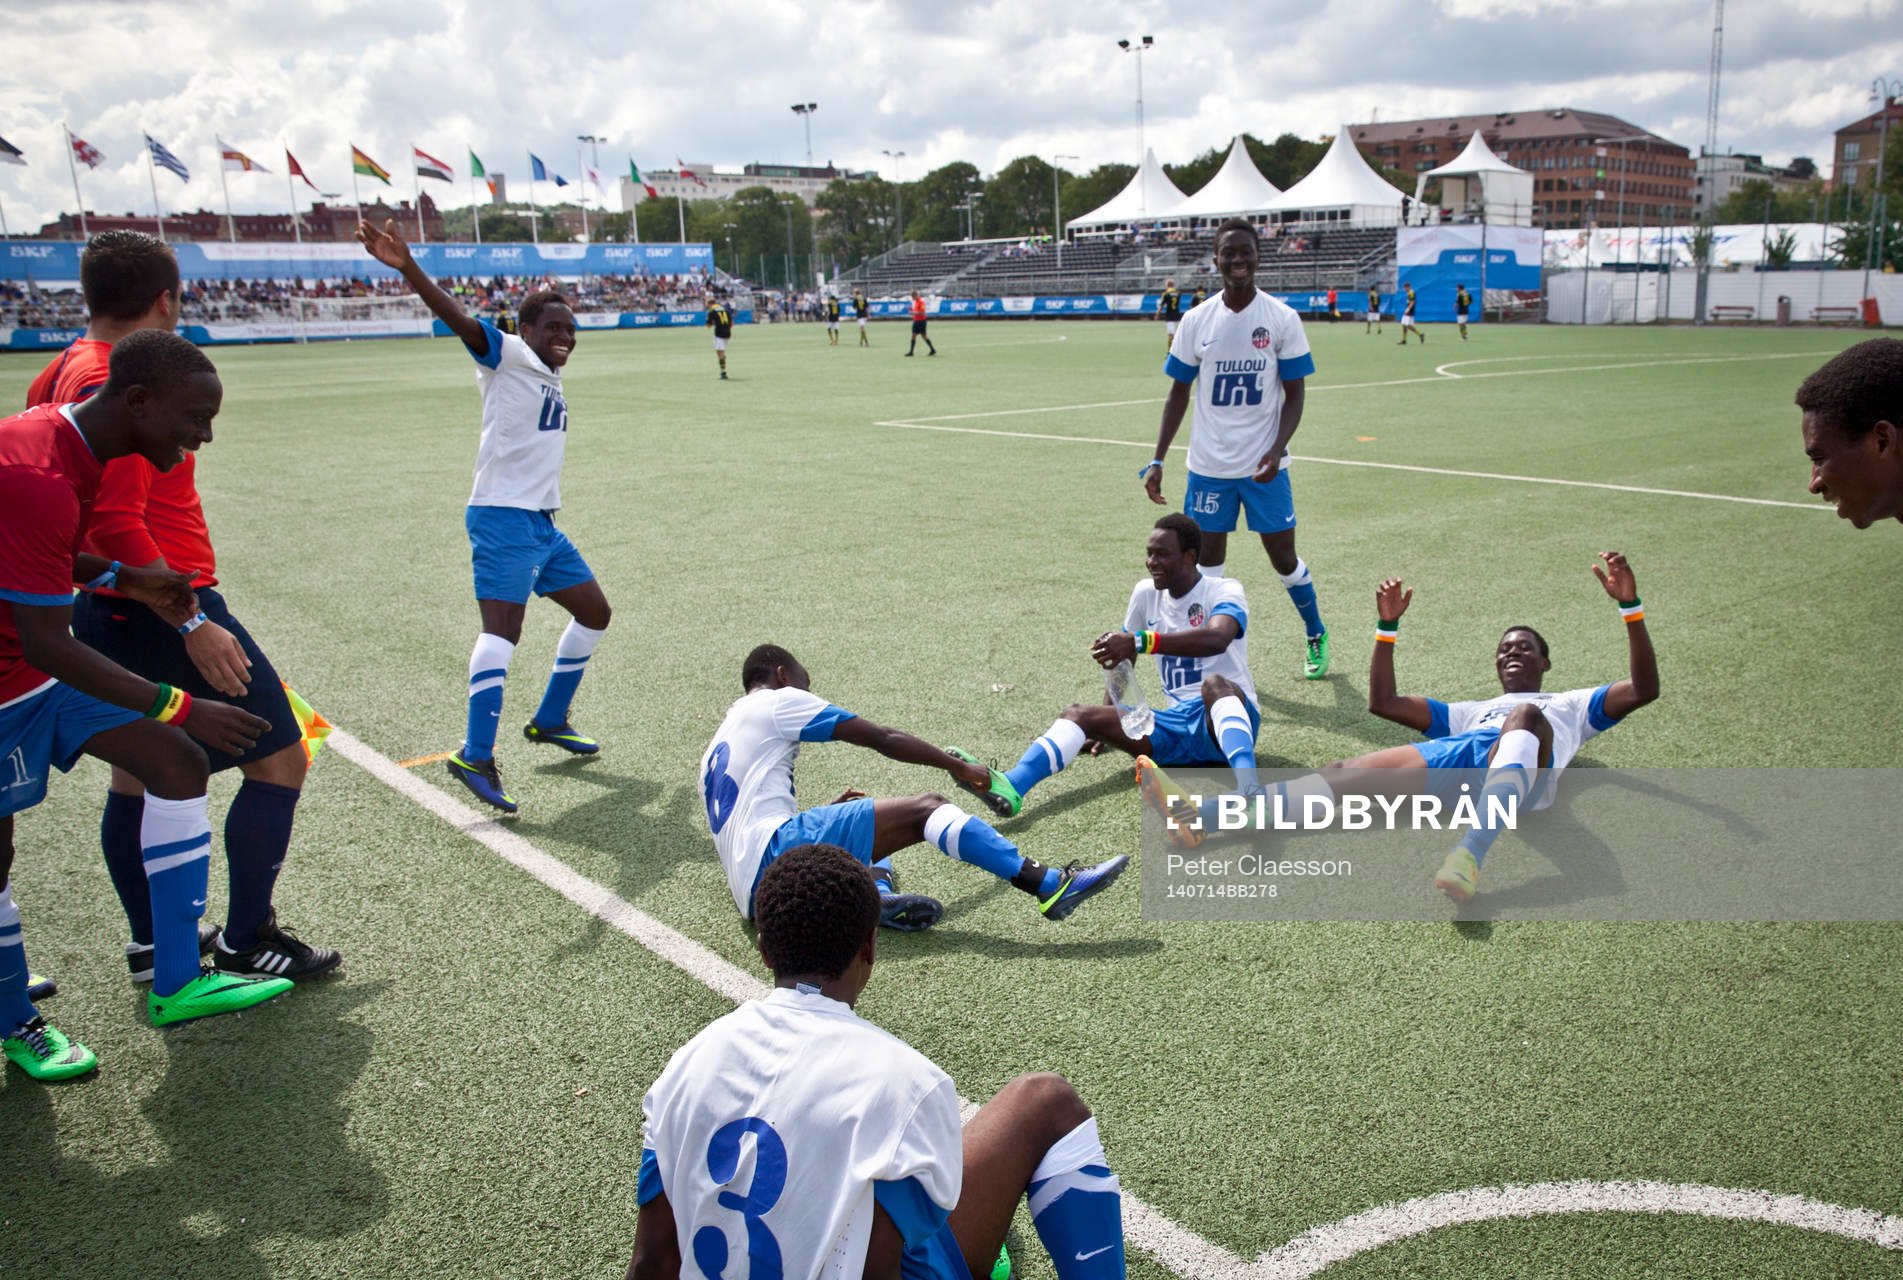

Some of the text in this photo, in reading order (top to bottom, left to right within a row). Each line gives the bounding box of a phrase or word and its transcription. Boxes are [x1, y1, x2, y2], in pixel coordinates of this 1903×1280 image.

[1215, 359, 1267, 373] TULLOW
[1211, 373, 1264, 406] OIL
[1193, 491, 1221, 515] 15
[704, 741, 739, 835] 8
[692, 1117, 788, 1280] 3
